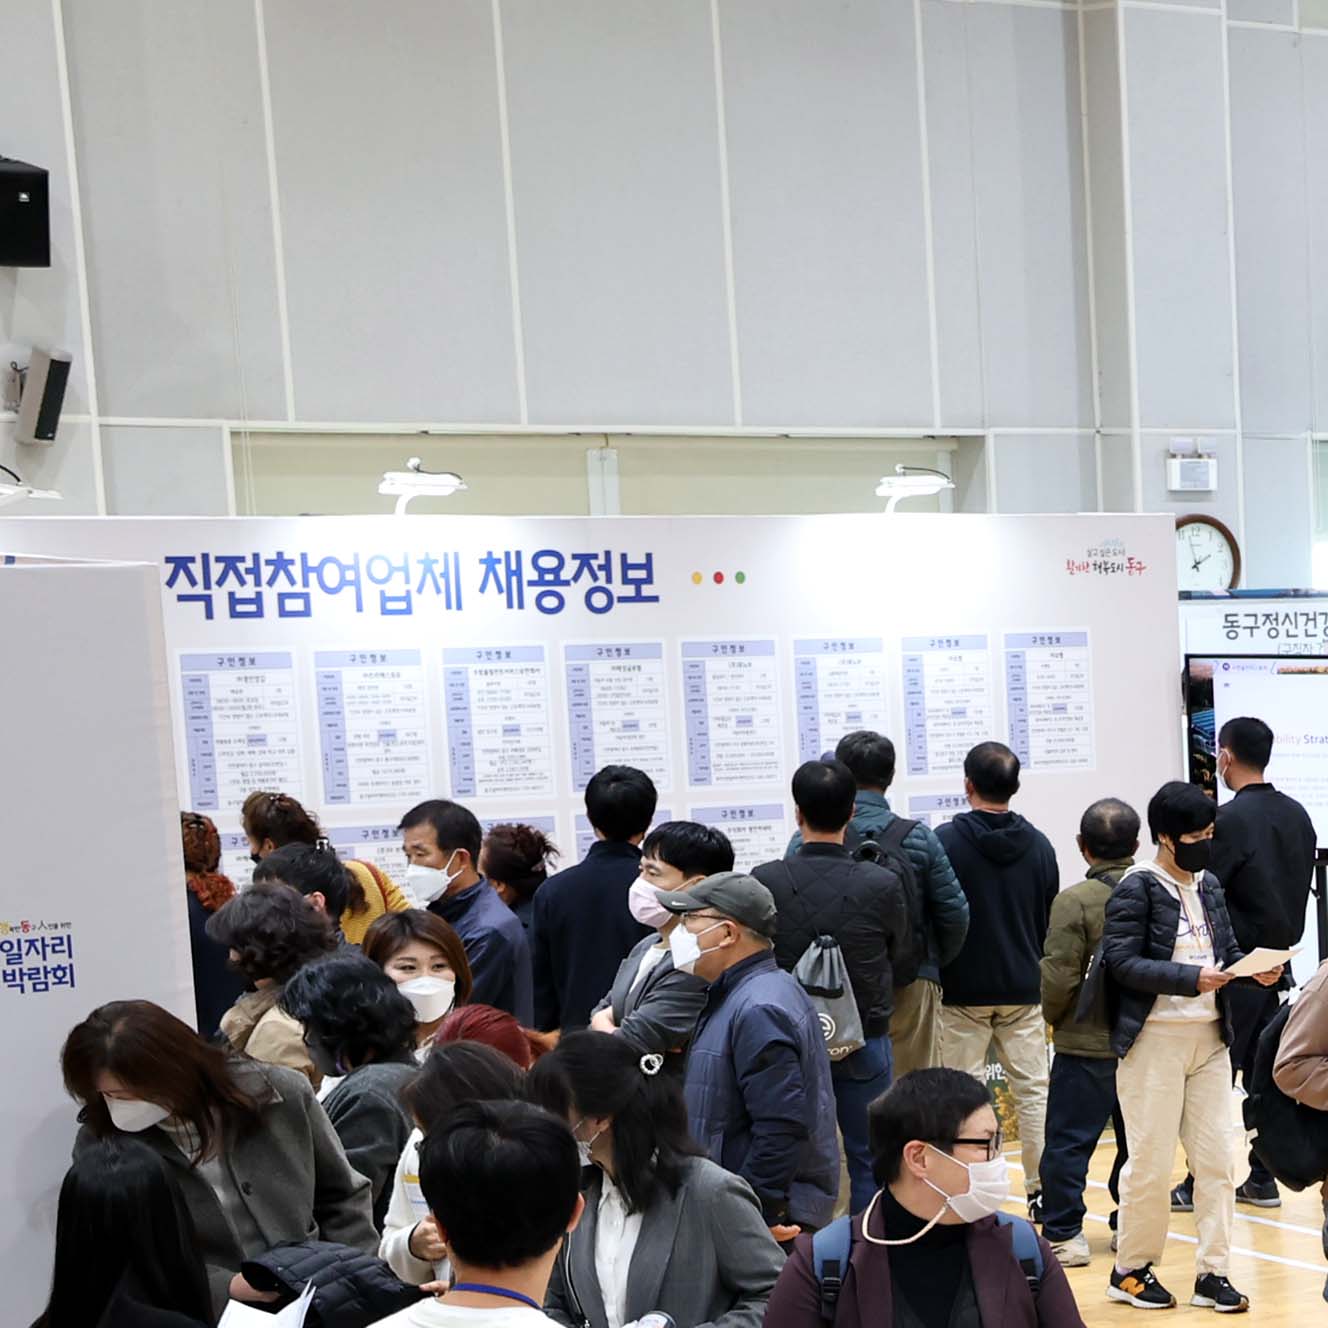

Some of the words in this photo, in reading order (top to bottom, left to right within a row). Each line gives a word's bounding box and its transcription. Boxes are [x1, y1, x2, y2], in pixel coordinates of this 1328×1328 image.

[164, 551, 463, 620] 직접참여업체
[478, 549, 660, 614] 채용정보
[0, 934, 72, 965] 일자리
[2, 963, 75, 994] 박람회
